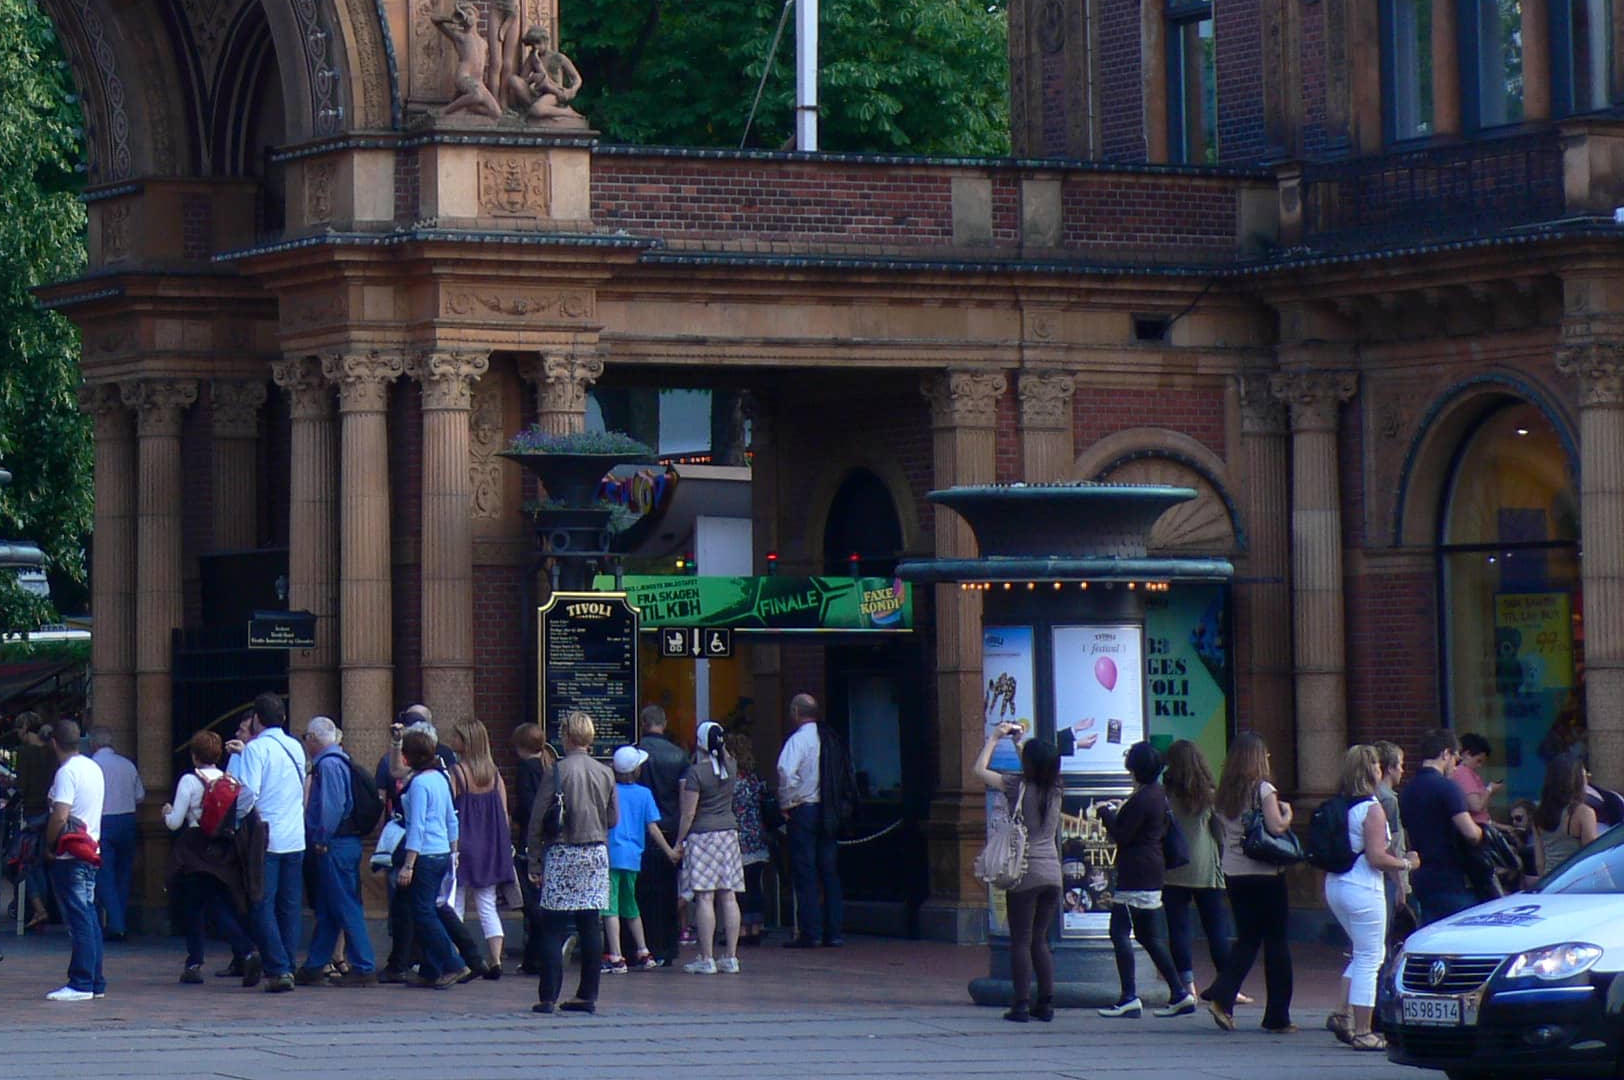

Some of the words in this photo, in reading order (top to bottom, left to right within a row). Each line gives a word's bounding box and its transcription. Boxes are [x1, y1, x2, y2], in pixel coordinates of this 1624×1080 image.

[637, 592, 657, 605] FRA
[658, 588, 700, 602] SKAGEN
[863, 587, 894, 602] FAXE
[566, 603, 613, 617] TIVOLI
[760, 590, 819, 617] FINALE
[860, 598, 900, 614] KONDI
[640, 604, 665, 621] TIL
[1149, 679, 1190, 696] OLI
[1154, 700, 1196, 717] KR.
